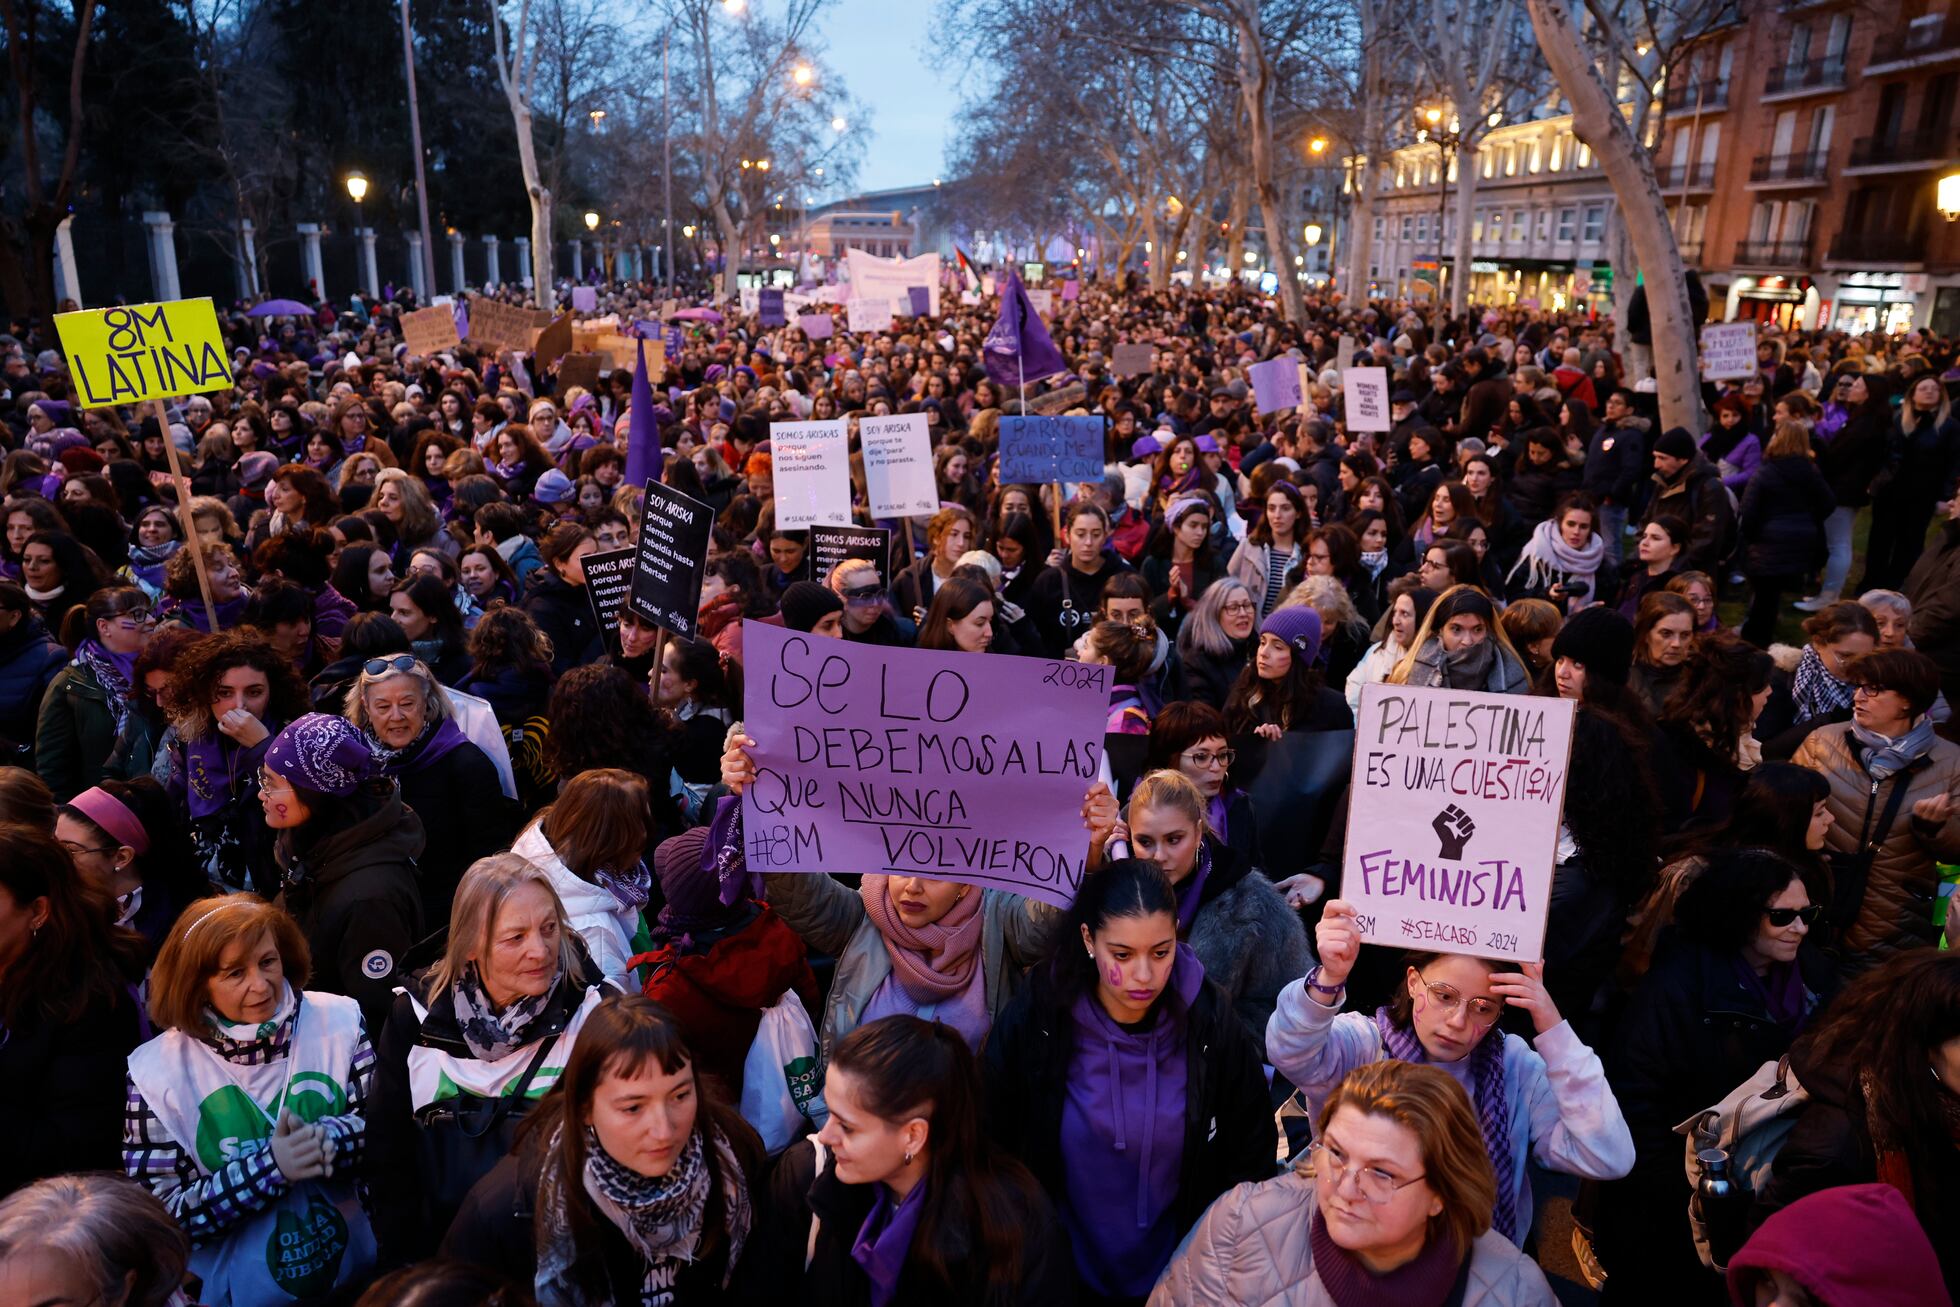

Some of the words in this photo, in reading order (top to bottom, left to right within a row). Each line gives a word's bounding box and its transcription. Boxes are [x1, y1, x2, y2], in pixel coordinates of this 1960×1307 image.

[104, 306, 173, 351] 8M
[74, 341, 232, 403] LATINA
[776, 429, 804, 441] SOMOS
[806, 428, 839, 439] ARISKAS
[866, 424, 881, 435] SOY
[883, 422, 911, 433] ARISKA
[867, 438, 893, 447] porque
[868, 446, 883, 455] dije
[779, 463, 828, 473] asesinando.
[870, 459, 875, 467] y
[647, 511, 673, 529] porque
[649, 494, 666, 510] SOY
[665, 501, 694, 525] ARISKA
[645, 523, 674, 543] siembro
[815, 533, 844, 545] SOMOS
[845, 535, 881, 547] ARISKAS
[642, 550, 673, 571] cosechar
[643, 537, 672, 556] rebeldía
[673, 550, 694, 567] hasta
[816, 546, 847, 555] porque
[587, 561, 616, 575] SOMOS
[592, 574, 622, 587] porque
[640, 561, 669, 583] libertad.
[772, 637, 850, 714] Se
[880, 664, 969, 722] LO
[1043, 662, 1105, 693] 2024
[1378, 696, 1545, 757] PALESTINA
[794, 726, 996, 776] DEBEMOS
[1002, 739, 1026, 776] A
[1037, 739, 1096, 779] LAS
[1367, 752, 1396, 787] ES
[1404, 755, 1446, 792] UNA
[751, 768, 825, 816] Que
[838, 781, 967, 825] NUNCA
[750, 822, 823, 866] #8M
[880, 826, 1084, 891] VOLVIERON
[1360, 849, 1526, 912] FEMINISTA
[1401, 918, 1477, 945] #SEACABÓ
[1485, 932, 1518, 953] 2024
